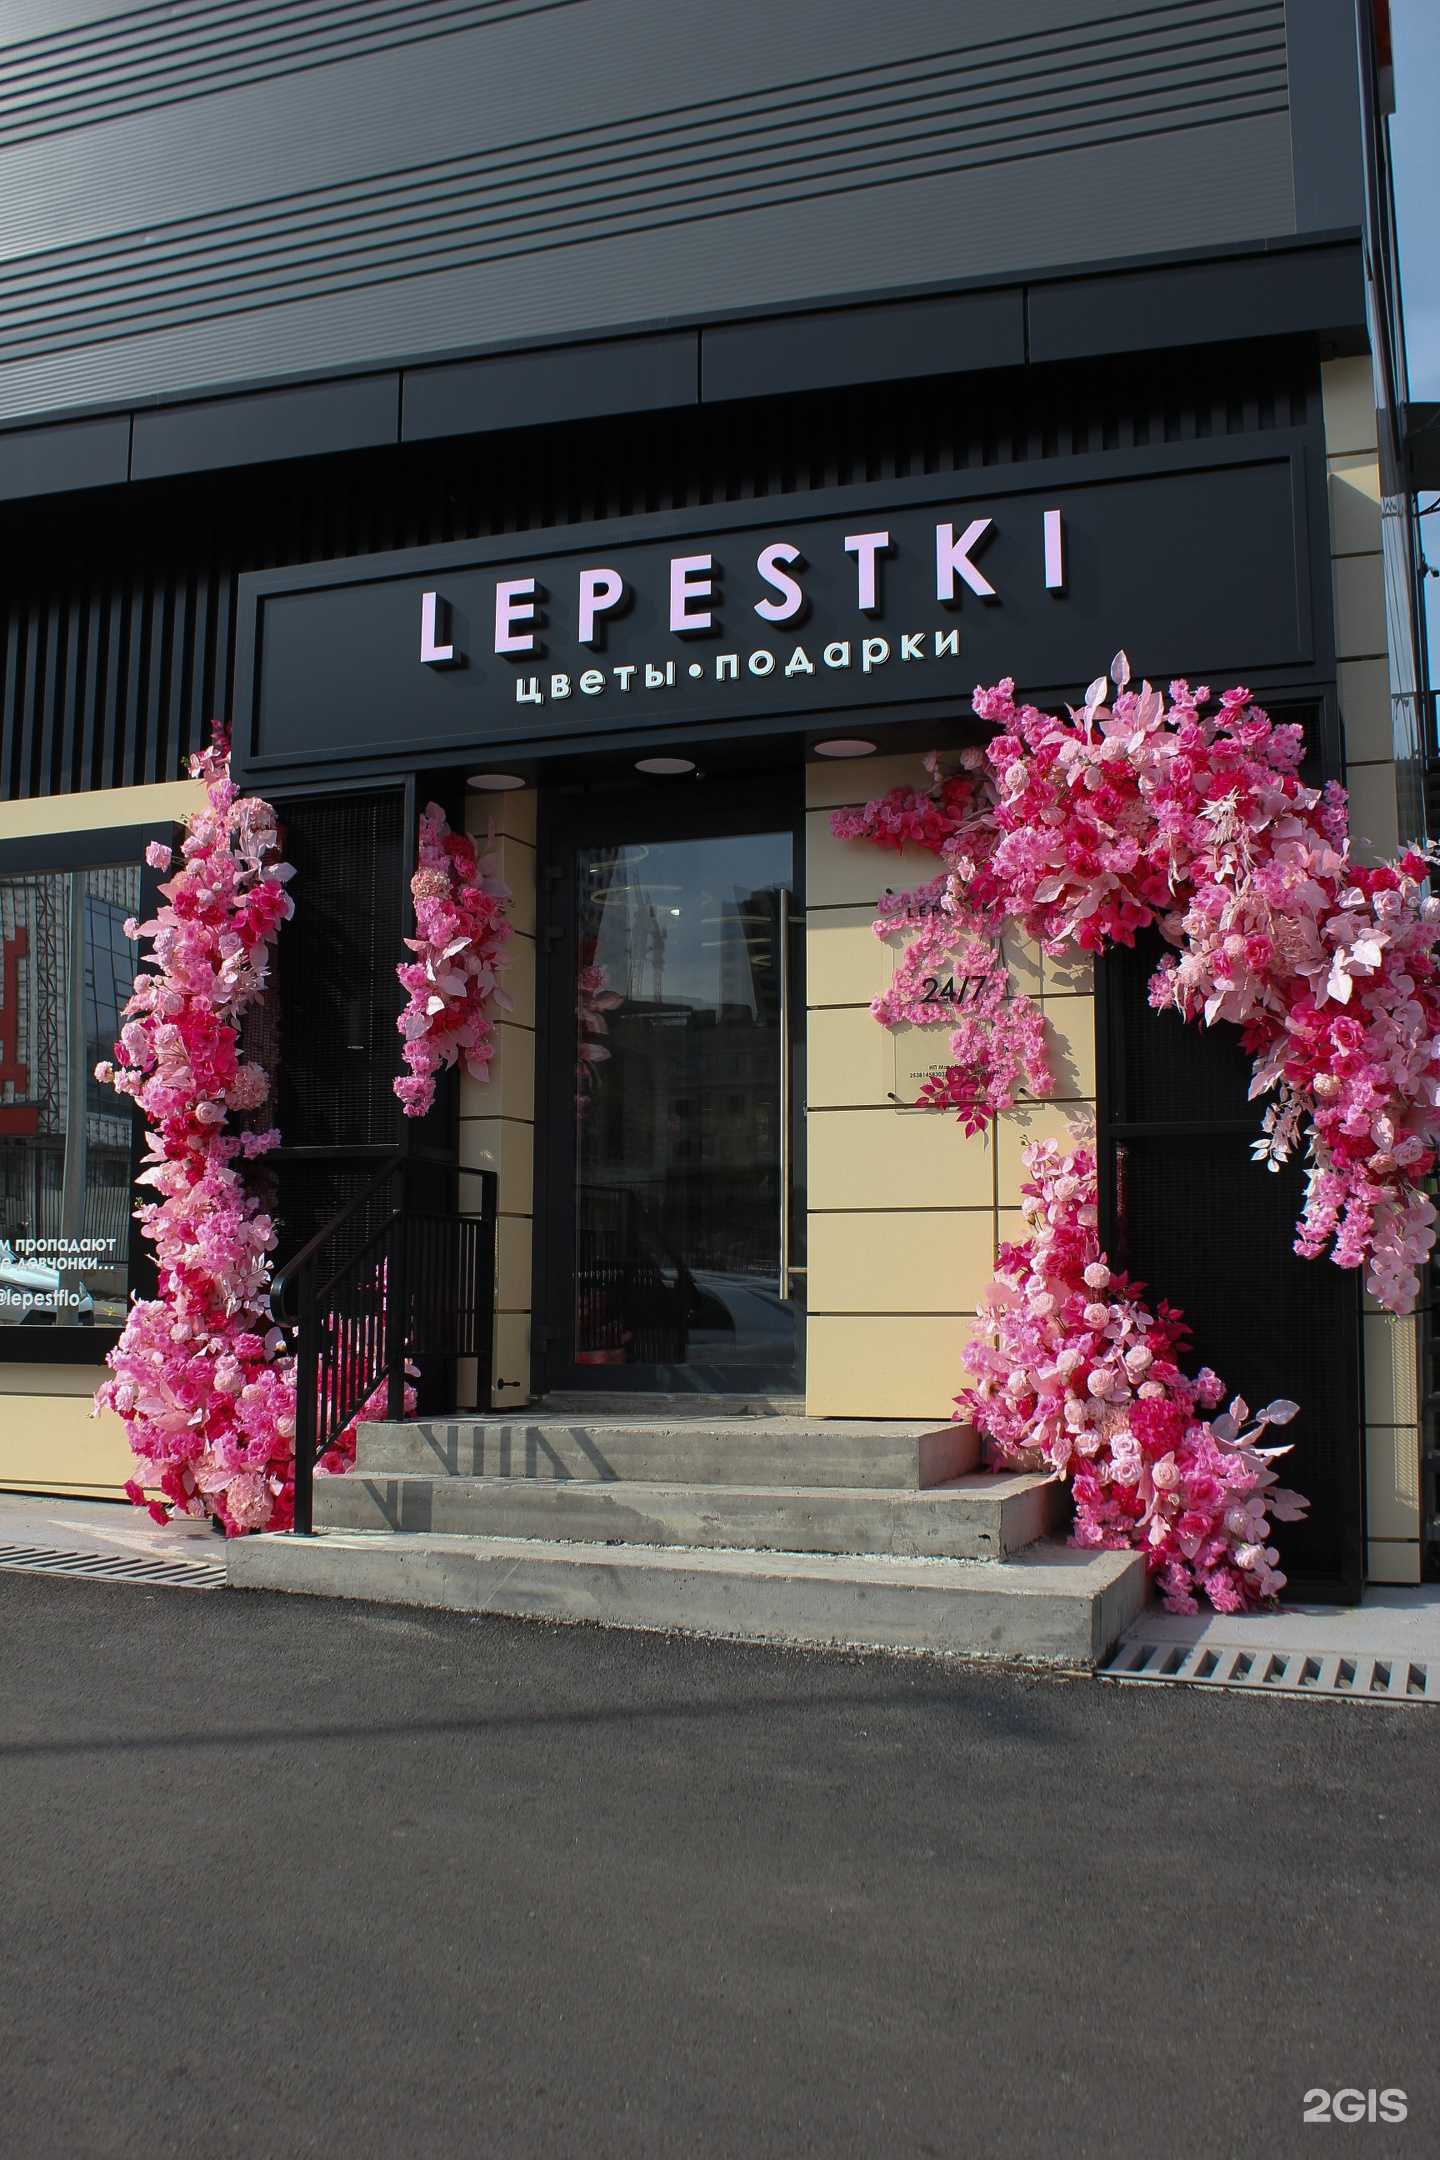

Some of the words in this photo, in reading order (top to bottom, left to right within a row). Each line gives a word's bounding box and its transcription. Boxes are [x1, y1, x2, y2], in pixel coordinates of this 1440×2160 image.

[420, 509, 1063, 664] LEPESTKI
[921, 975, 987, 1004] 24/7
[15, 1238, 116, 1256] пропадают
